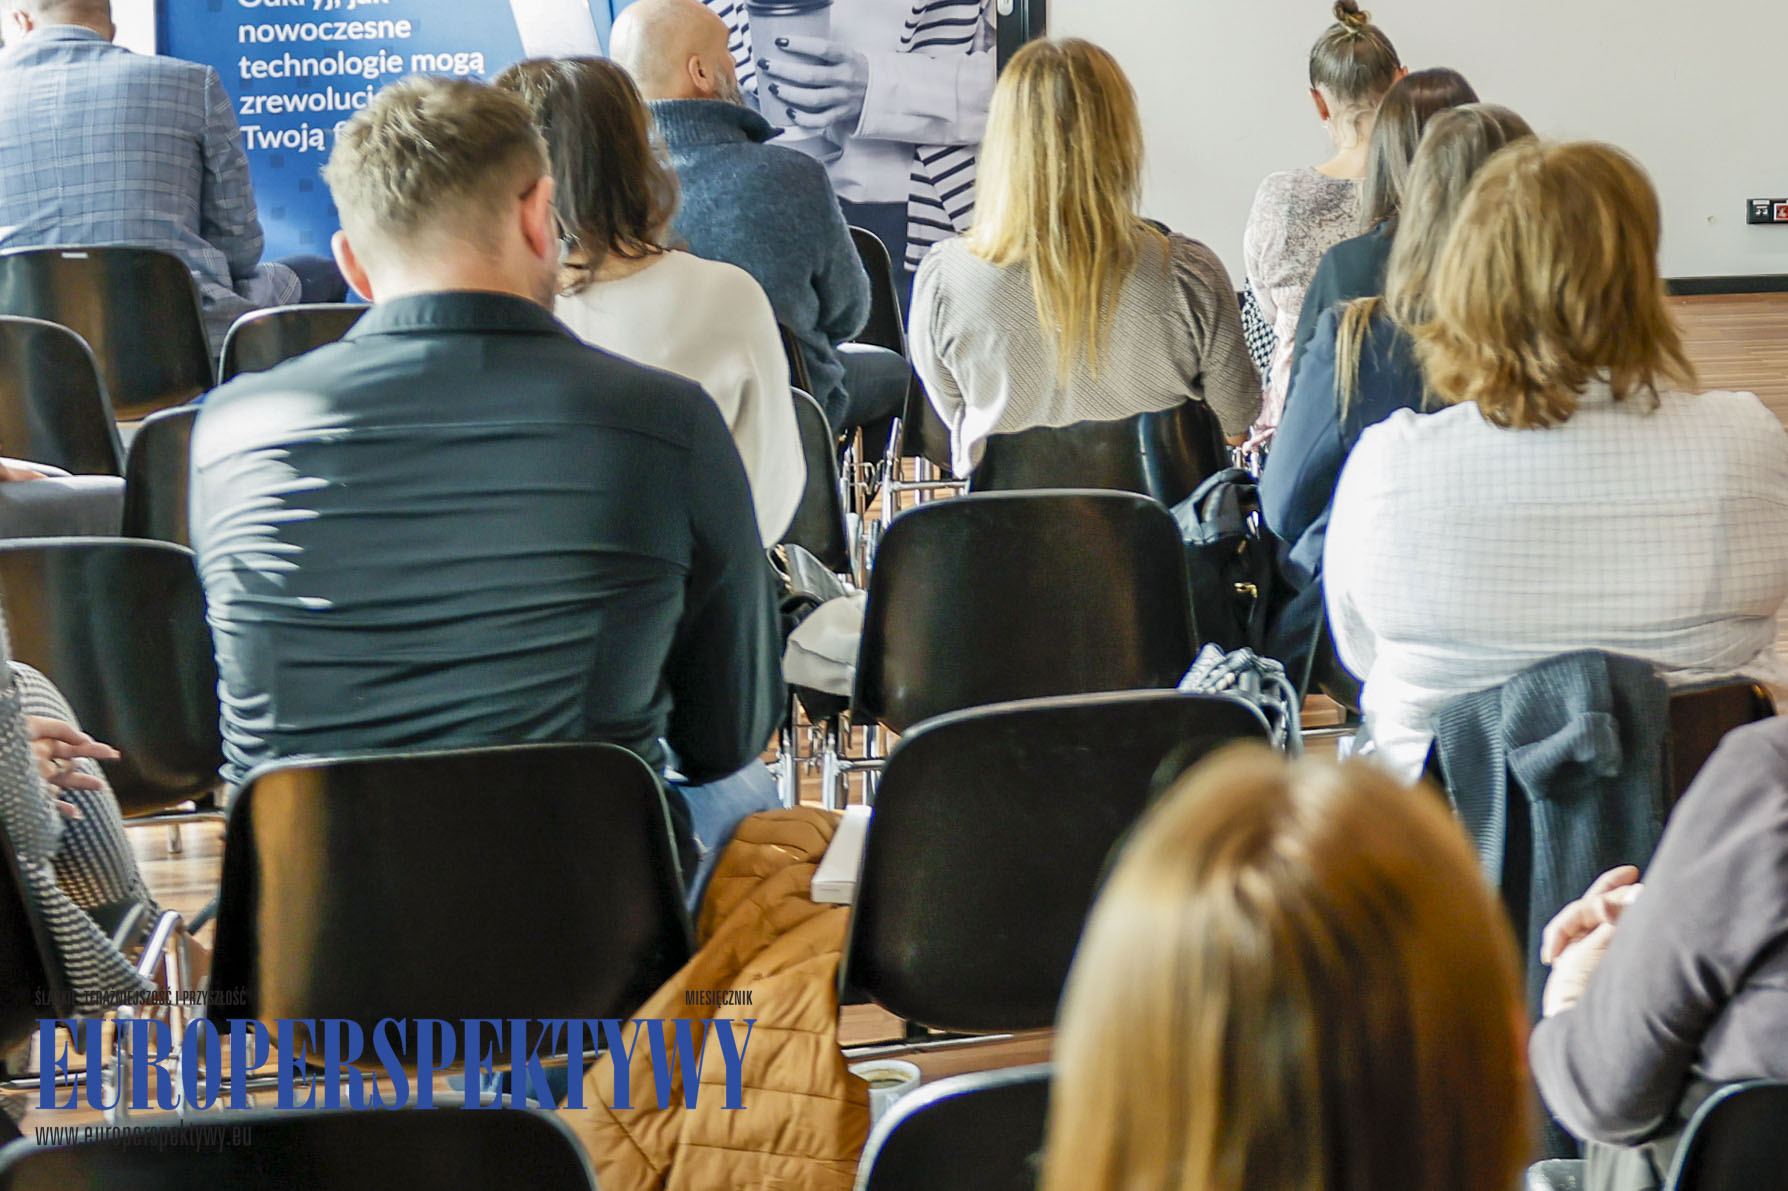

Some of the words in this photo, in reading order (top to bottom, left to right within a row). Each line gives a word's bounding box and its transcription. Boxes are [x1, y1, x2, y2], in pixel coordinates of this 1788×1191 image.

[238, 16, 412, 44] nowoczesne
[239, 50, 404, 81] technologie
[411, 52, 485, 77] mogą
[242, 124, 326, 153] Twoją
